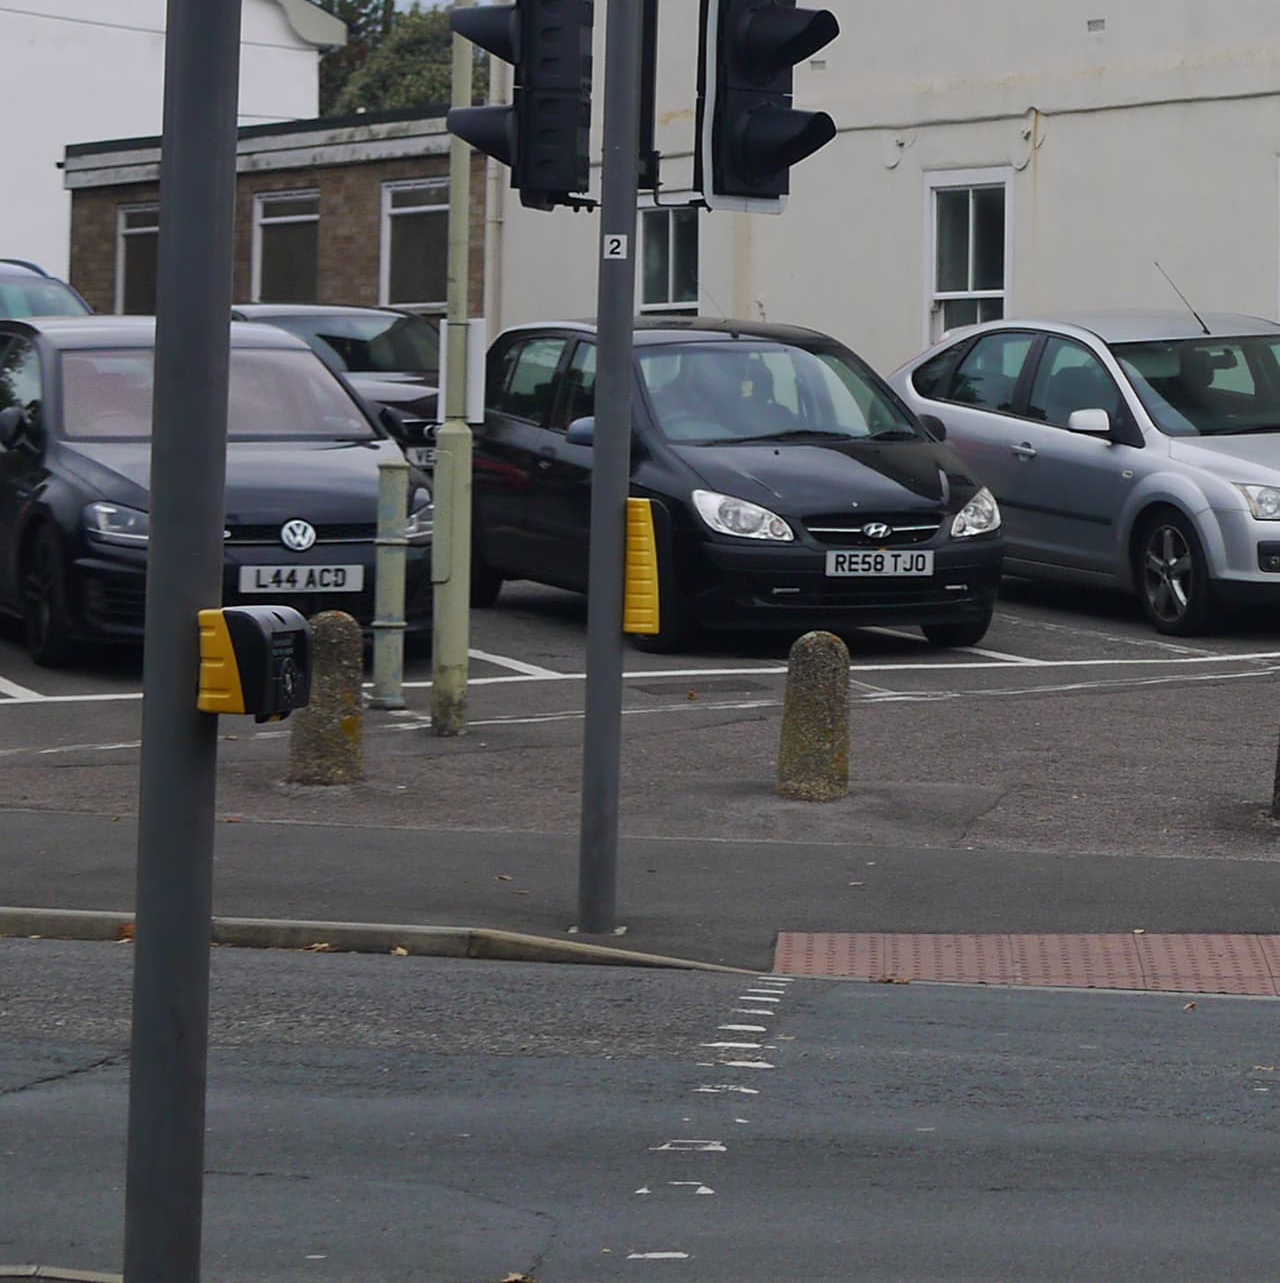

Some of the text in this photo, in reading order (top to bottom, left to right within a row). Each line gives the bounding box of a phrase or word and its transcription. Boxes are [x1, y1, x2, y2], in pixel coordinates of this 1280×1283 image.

[609, 238, 621, 255] 2
[834, 553, 885, 573] RE58
[255, 567, 347, 589] L44 ACD
